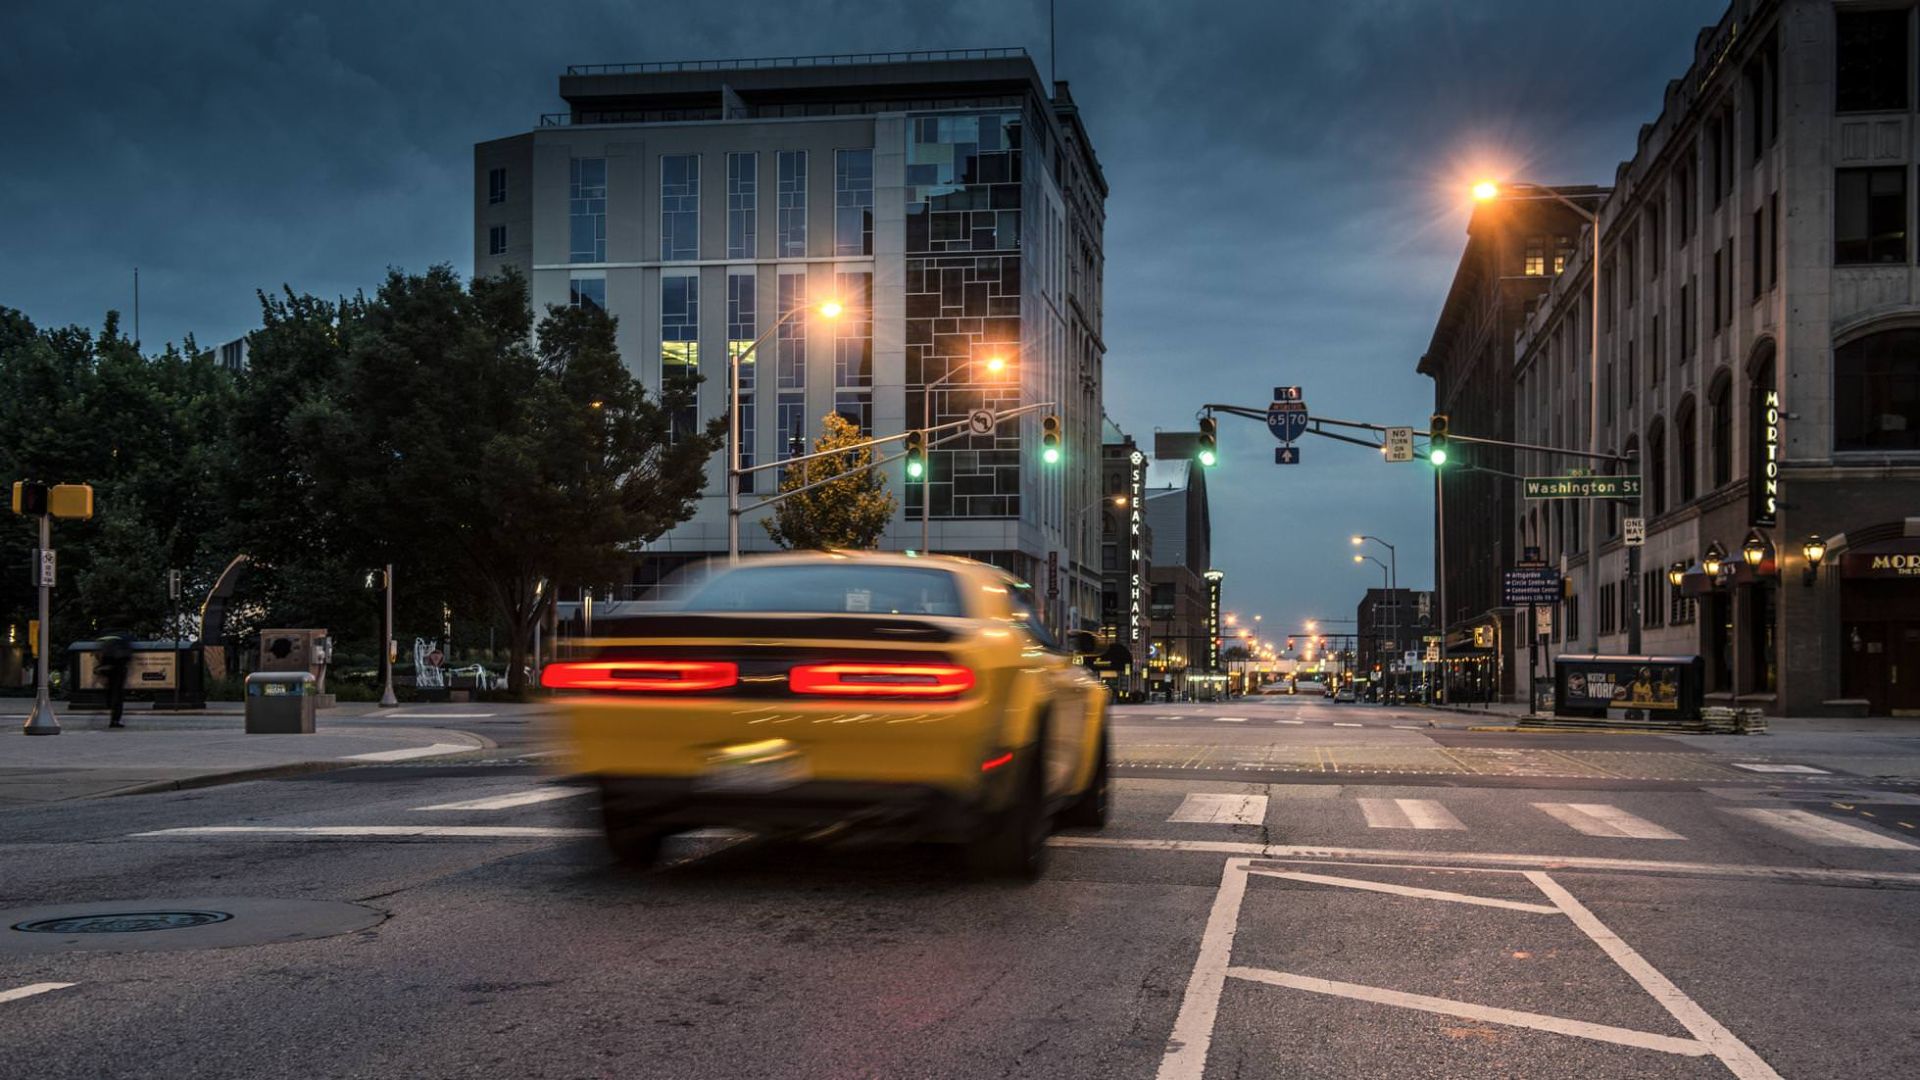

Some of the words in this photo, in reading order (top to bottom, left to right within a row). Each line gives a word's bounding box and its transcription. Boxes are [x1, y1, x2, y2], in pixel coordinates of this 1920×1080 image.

[1281, 388, 1296, 399] TO
[1269, 414, 1285, 425] 65
[1289, 414, 1306, 425] 70
[1528, 481, 1616, 496] Washington
[1622, 480, 1639, 492] St
[1131, 469, 1140, 535] STEAK
[1625, 520, 1643, 528] ONE
[1131, 549, 1140, 561] N
[1131, 574, 1140, 640] SHAKE
